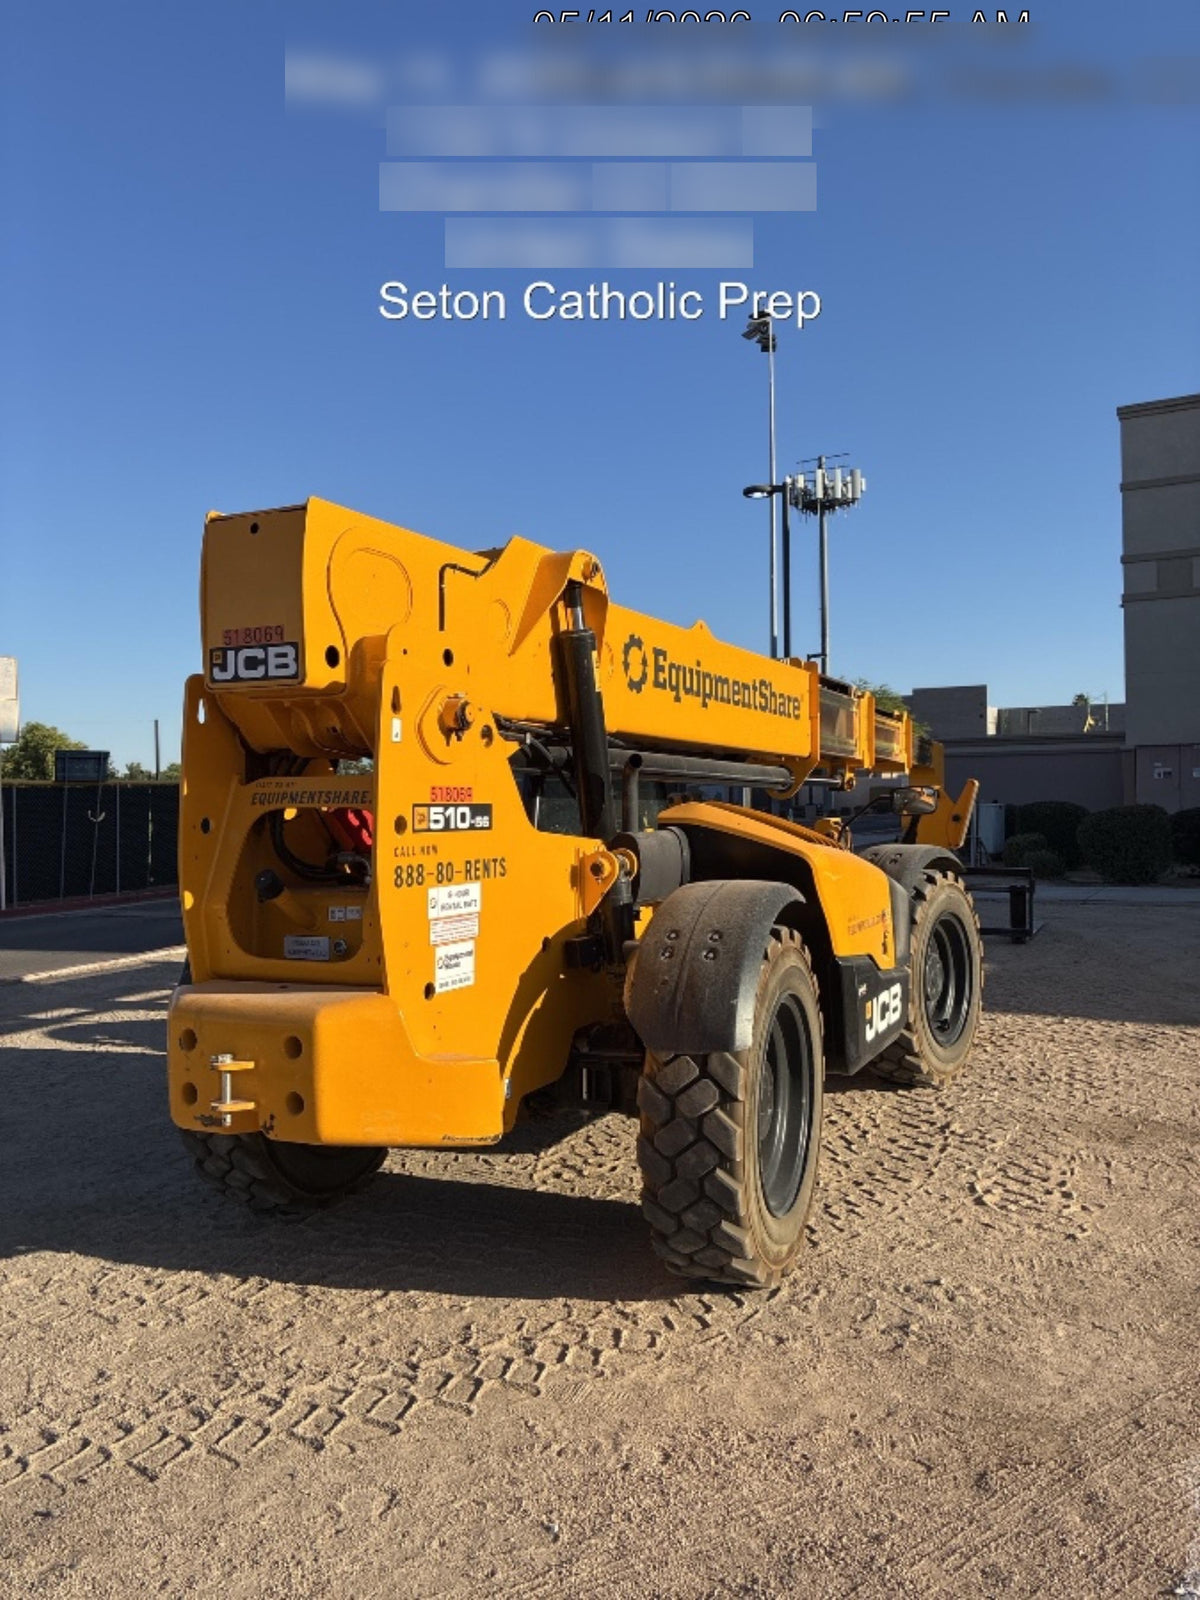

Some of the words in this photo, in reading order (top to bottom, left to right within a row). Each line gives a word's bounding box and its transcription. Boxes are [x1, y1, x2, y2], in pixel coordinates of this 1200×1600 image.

[223, 625, 285, 646] 518069
[212, 645, 298, 680] JCB
[652, 646, 801, 721] EquipmentShare
[393, 846, 416, 858] CALL
[393, 856, 508, 889] 888-80-RENTS
[865, 982, 903, 1044] JCB
